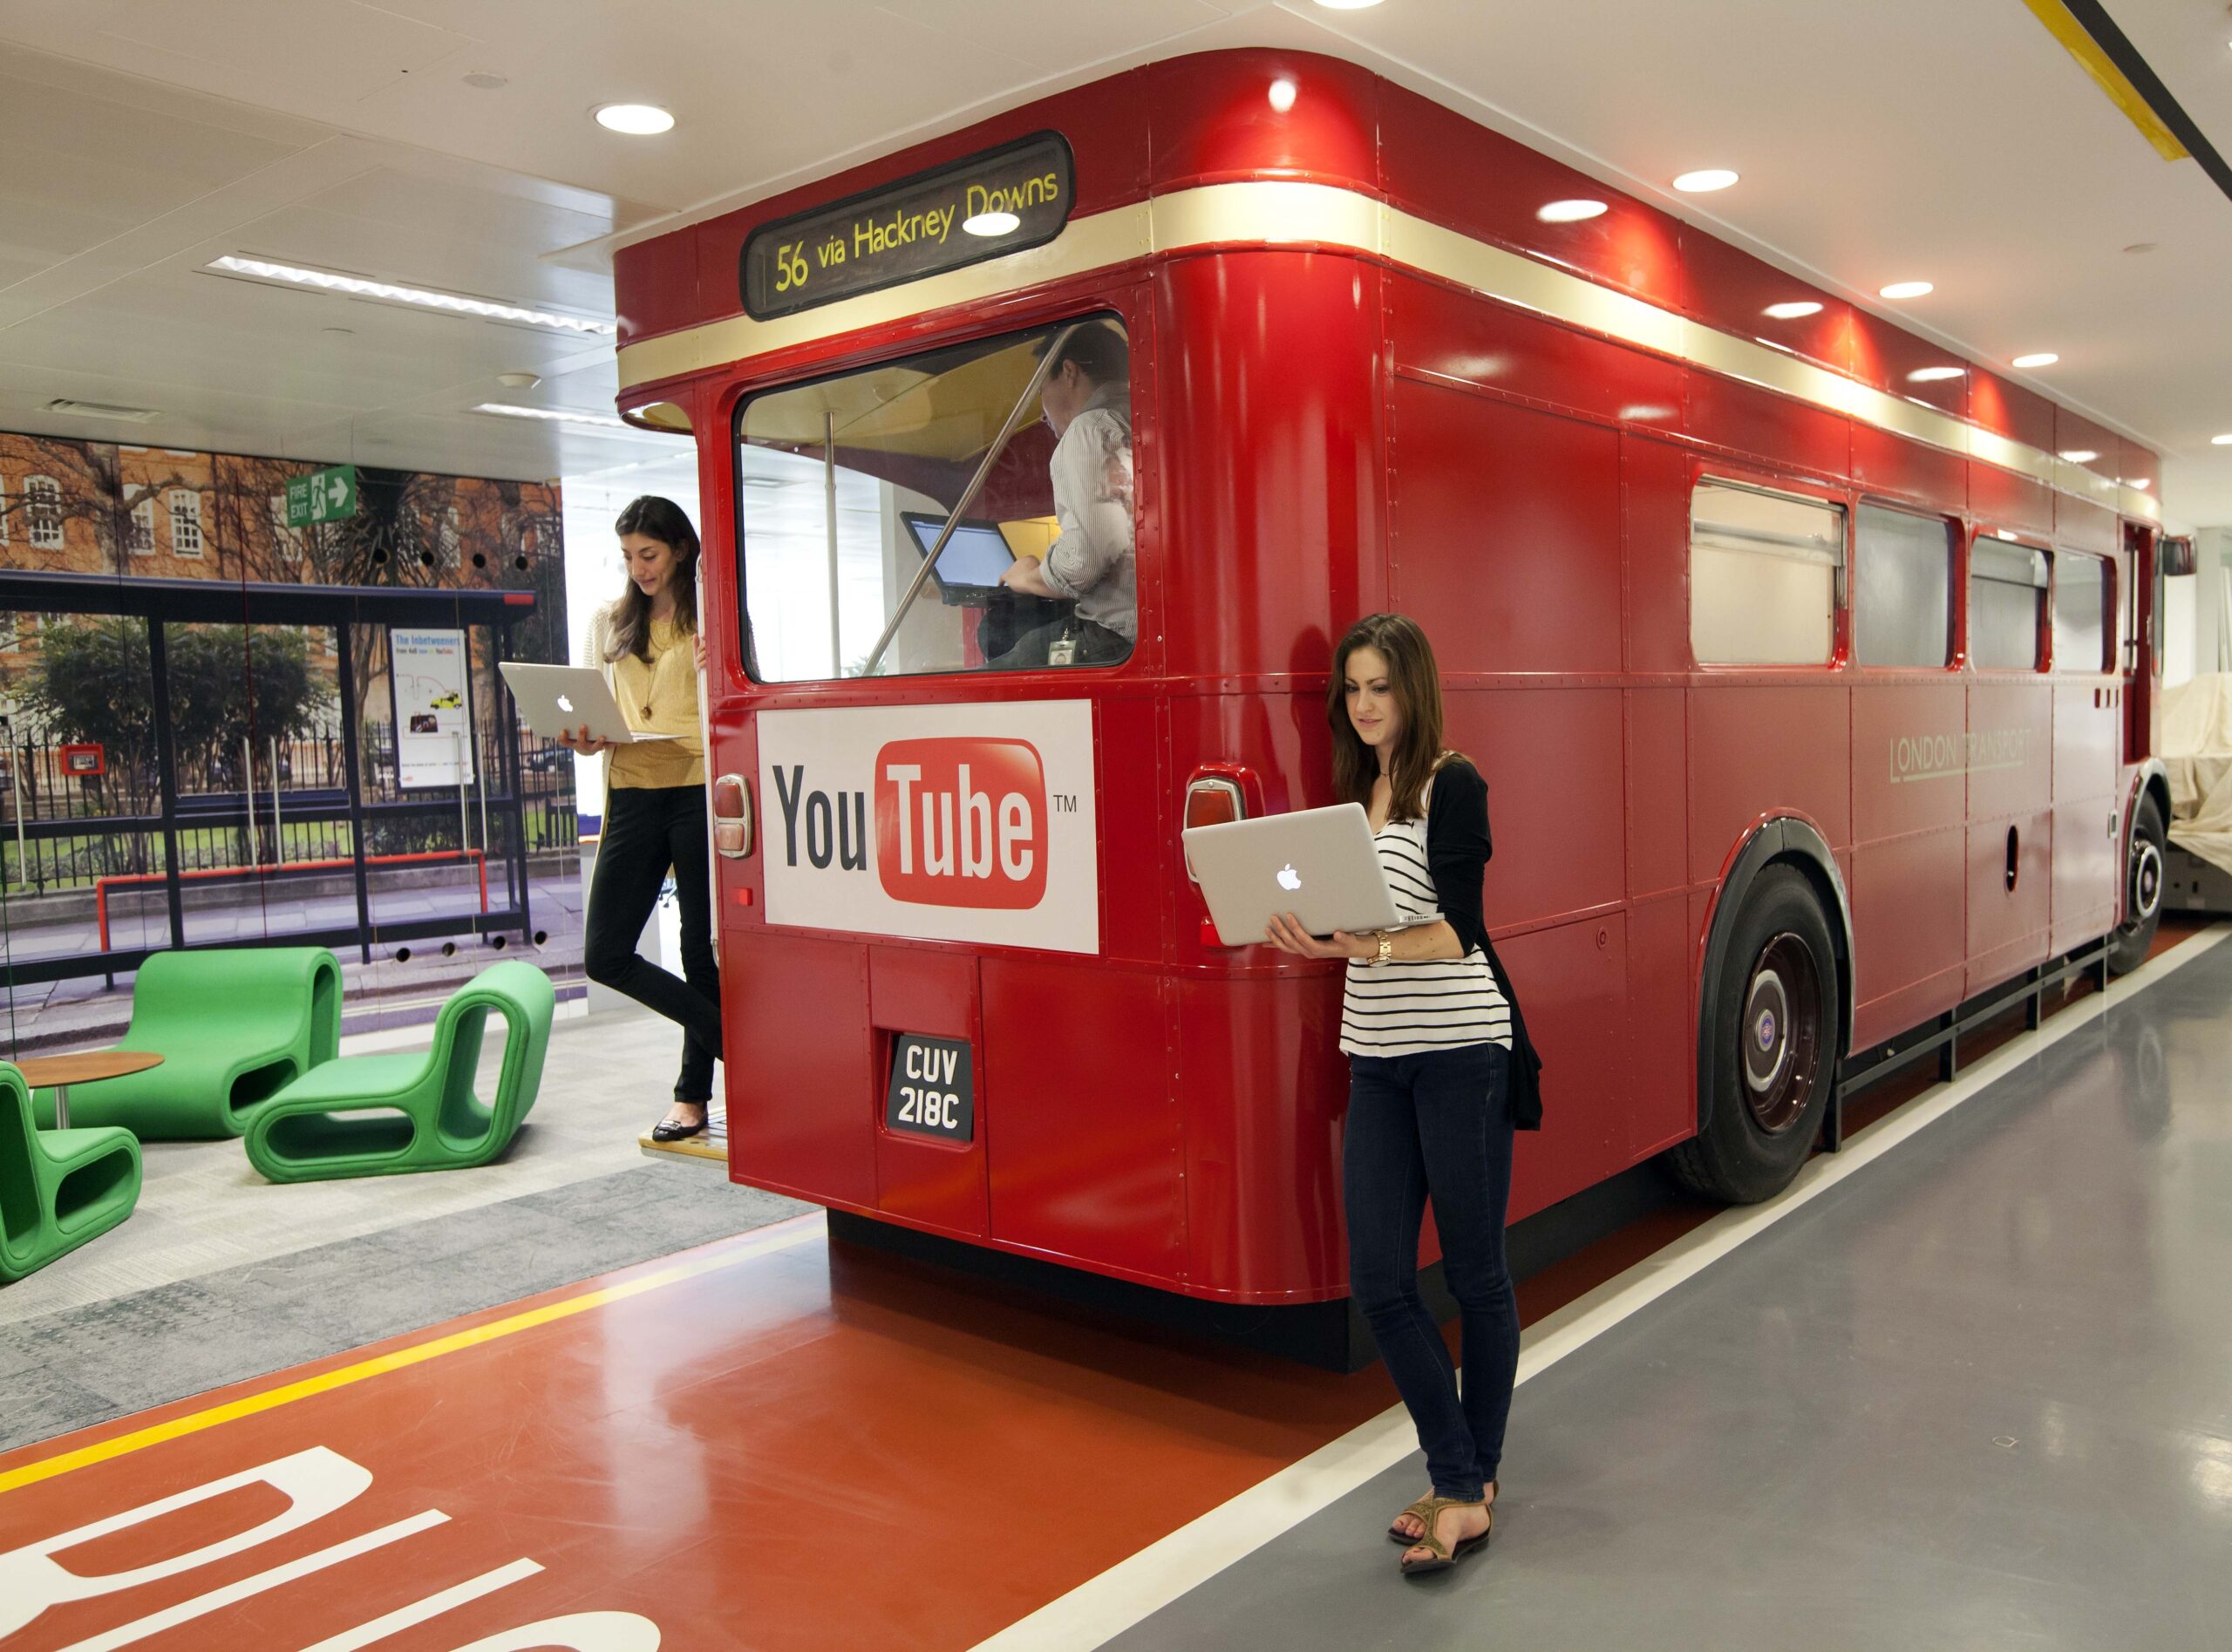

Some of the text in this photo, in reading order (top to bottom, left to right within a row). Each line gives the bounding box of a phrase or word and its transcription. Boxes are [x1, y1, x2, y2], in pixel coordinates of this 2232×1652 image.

[775, 172, 1058, 292] 56 via Hackney Downs
[289, 482, 308, 500] FIRE
[290, 501, 308, 520] EXIT
[396, 635, 410, 645] The
[1889, 729, 2032, 784] LONDON TRANSPORT
[772, 764, 1078, 881] YouTube TM
[906, 1044, 958, 1085] CUV
[898, 1086, 959, 1130] 218C
